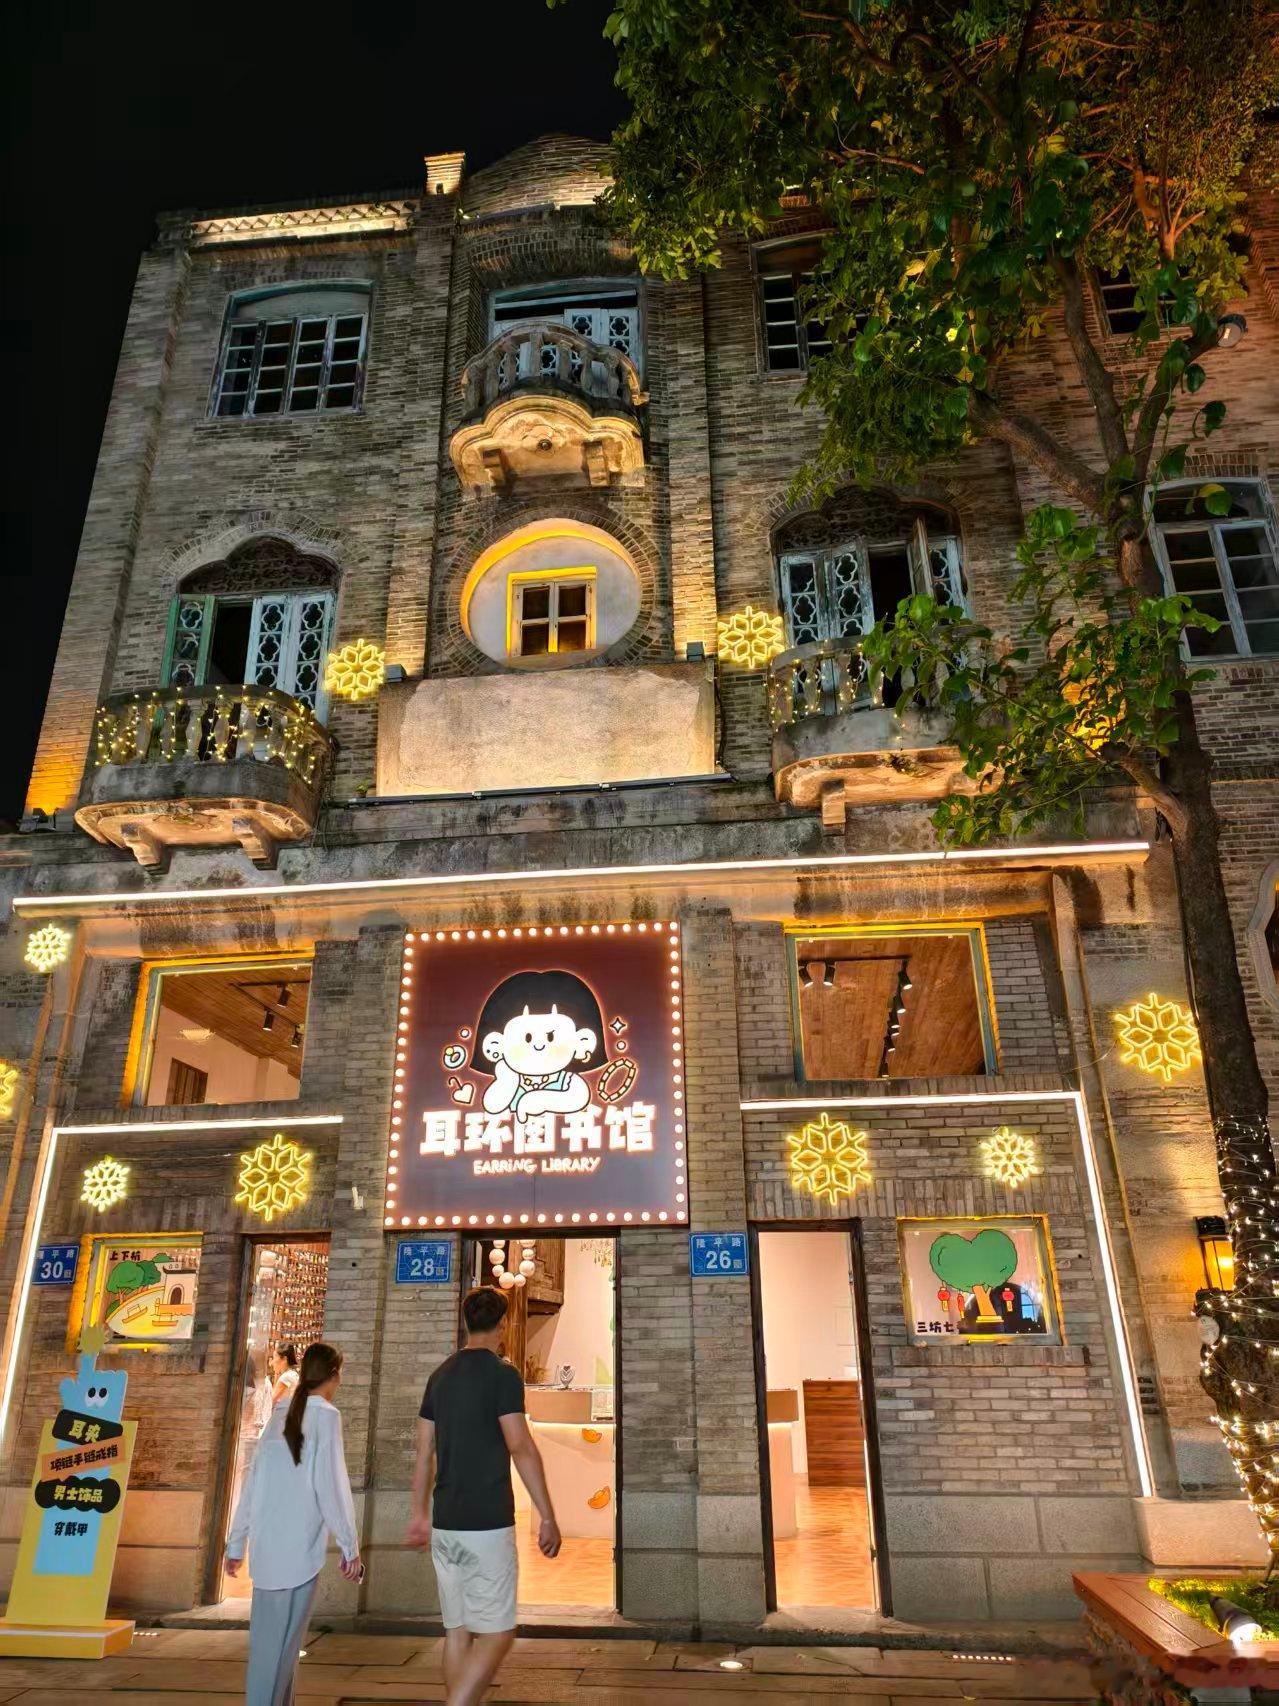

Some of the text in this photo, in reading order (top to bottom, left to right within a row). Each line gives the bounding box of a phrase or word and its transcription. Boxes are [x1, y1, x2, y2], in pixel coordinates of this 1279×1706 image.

[419, 1101, 655, 1155] 耳环图书馆
[410, 1258, 434, 1277] 28
[706, 1250, 731, 1269] 26
[41, 1261, 64, 1279] 30
[917, 1321, 961, 1333] 三坊七
[50, 1444, 118, 1472] 项链手链戒指
[53, 1485, 103, 1503] 男士饰品
[54, 1521, 89, 1537] 穿戴甲
